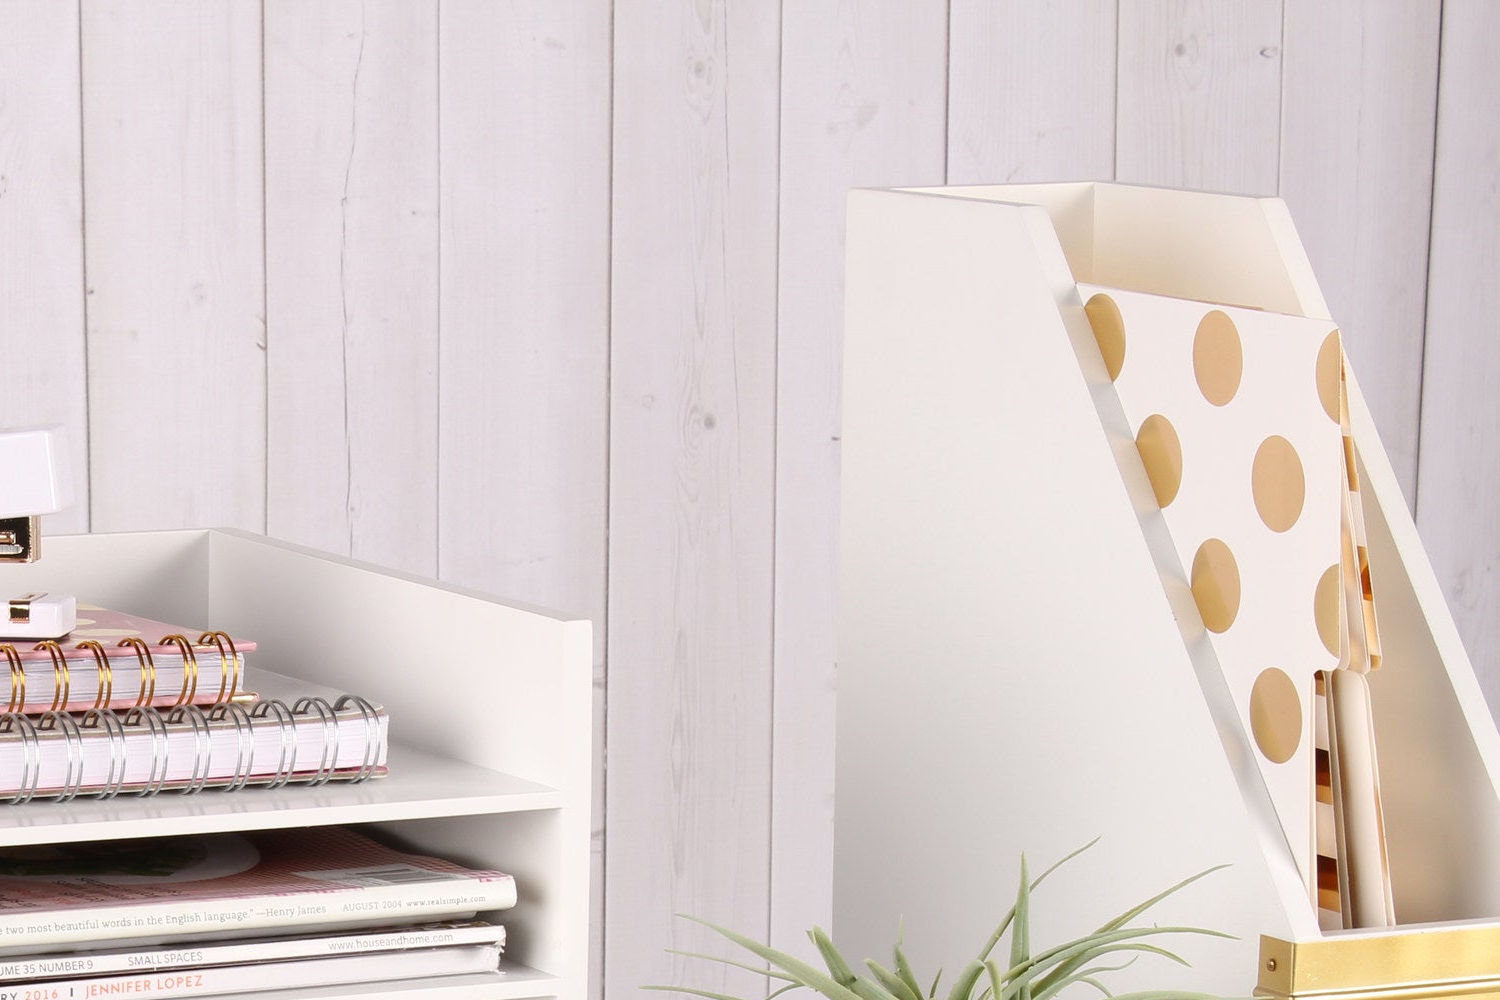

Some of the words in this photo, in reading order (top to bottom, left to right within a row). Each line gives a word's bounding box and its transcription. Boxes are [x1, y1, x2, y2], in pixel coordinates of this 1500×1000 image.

[342, 901, 379, 912] AUGUST
[406, 895, 486, 908] www.realsimple.com
[6, 926, 24, 935] two
[27, 924, 52, 934] most
[55, 918, 99, 932] beautiful
[102, 917, 132, 929] words
[134, 916, 145, 926] in
[147, 914, 163, 925] the
[166, 912, 201, 925] English
[297, 905, 327, 916] James
[328, 933, 454, 951] www.houseandhome.com
[23, 963, 36, 974] 35
[39, 961, 85, 973] NUMBER
[86, 959, 94, 969] 9
[128, 954, 162, 967] SMALL
[164, 952, 203, 964] SPACES
[25, 989, 59, 1000] 2016
[85, 979, 151, 999] JENNIFER
[157, 975, 203, 990] LOPEZ
